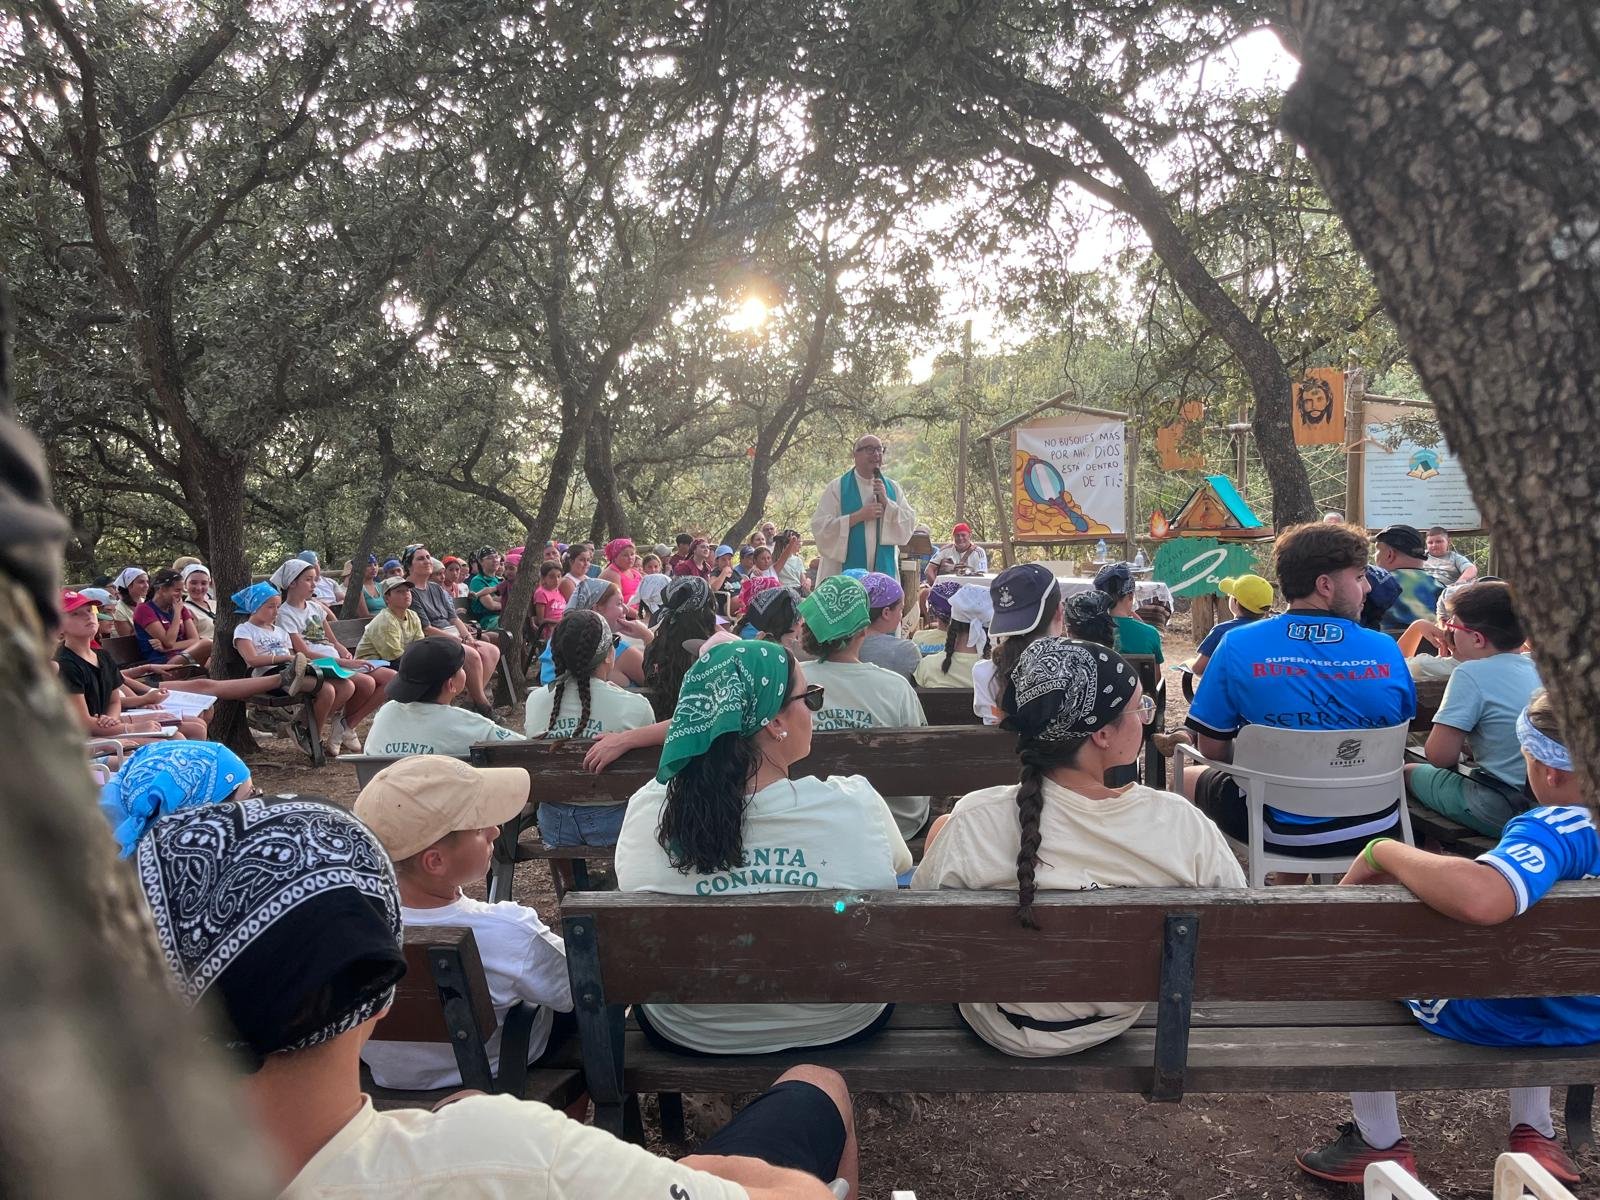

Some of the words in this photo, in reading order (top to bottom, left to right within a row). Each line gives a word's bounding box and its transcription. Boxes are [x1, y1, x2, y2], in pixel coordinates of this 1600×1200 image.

[1044, 438, 1057, 447] NO
[1060, 433, 1094, 446] BUSQUES
[1051, 449, 1069, 460] POR
[1086, 461, 1119, 471] DENTRO
[1083, 476, 1096, 487] DE
[1288, 622, 1343, 643] ULB
[1265, 656, 1377, 667] SUPERMERCADOS
[1309, 689, 1344, 708] LA
[817, 708, 872, 724] CUENTA
[385, 742, 434, 755] CUENTA
[740, 848, 806, 867] ENTA
[1506, 843, 1546, 874] hp
[695, 868, 818, 896] CONMIGO
